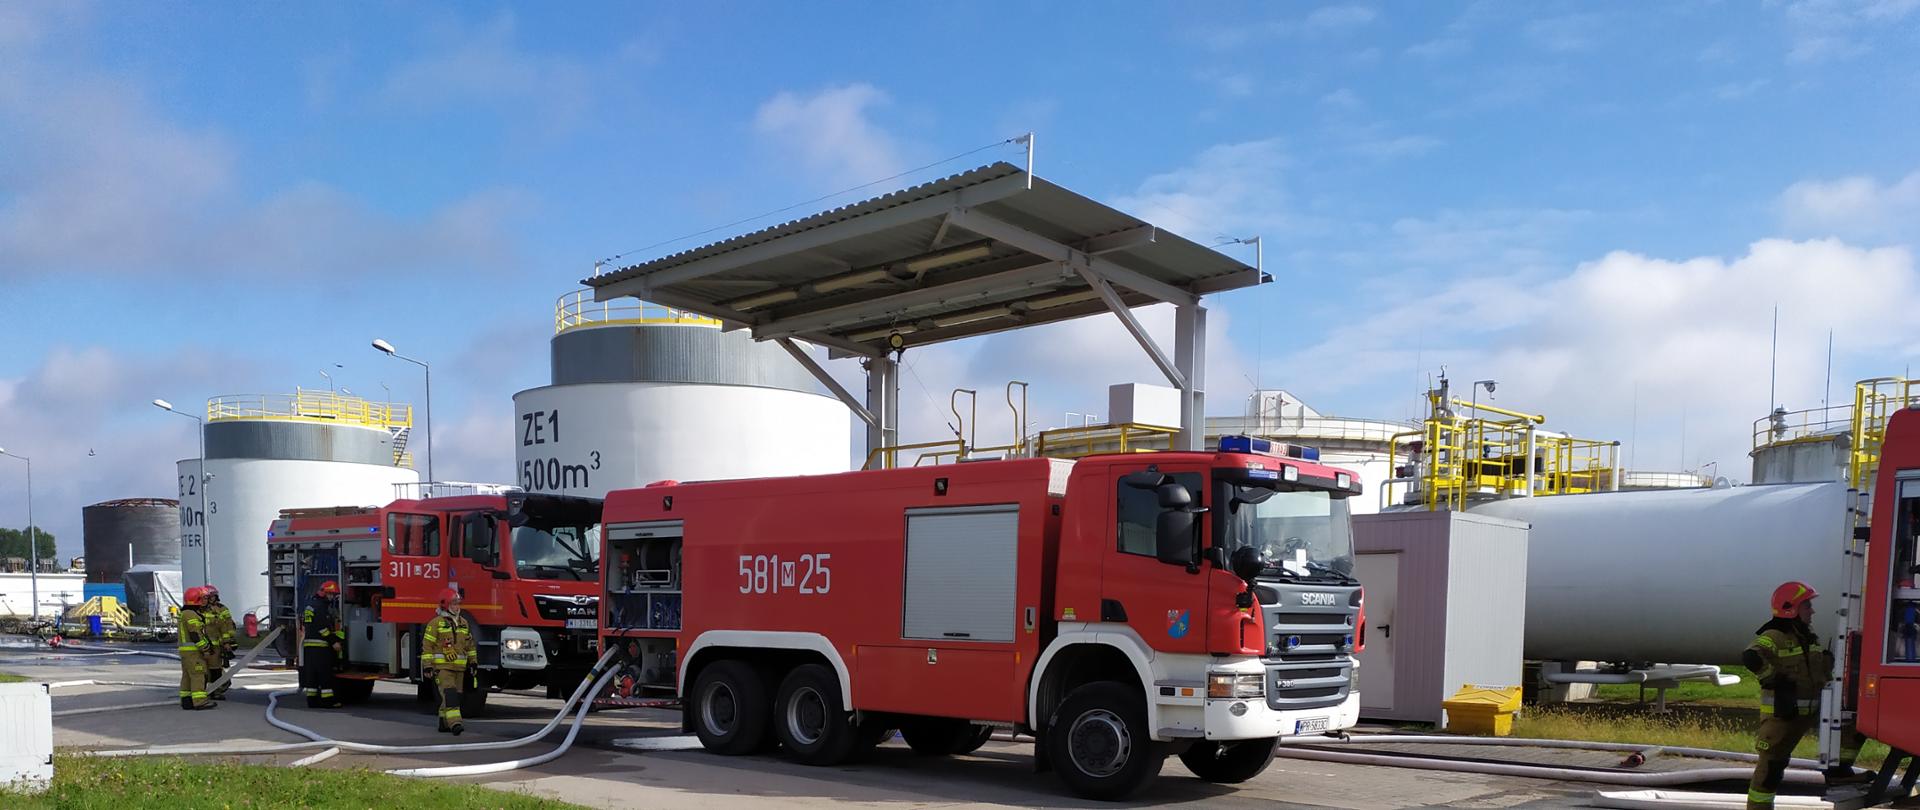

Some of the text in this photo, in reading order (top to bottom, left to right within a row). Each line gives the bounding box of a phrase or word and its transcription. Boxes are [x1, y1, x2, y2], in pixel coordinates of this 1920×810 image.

[188, 474, 196, 496] 2
[389, 561, 411, 578] 311
[423, 563, 441, 579] 25
[739, 553, 831, 594] 581 M 25
[1302, 592, 1336, 606] SCANIA
[567, 608, 596, 616] MAN
